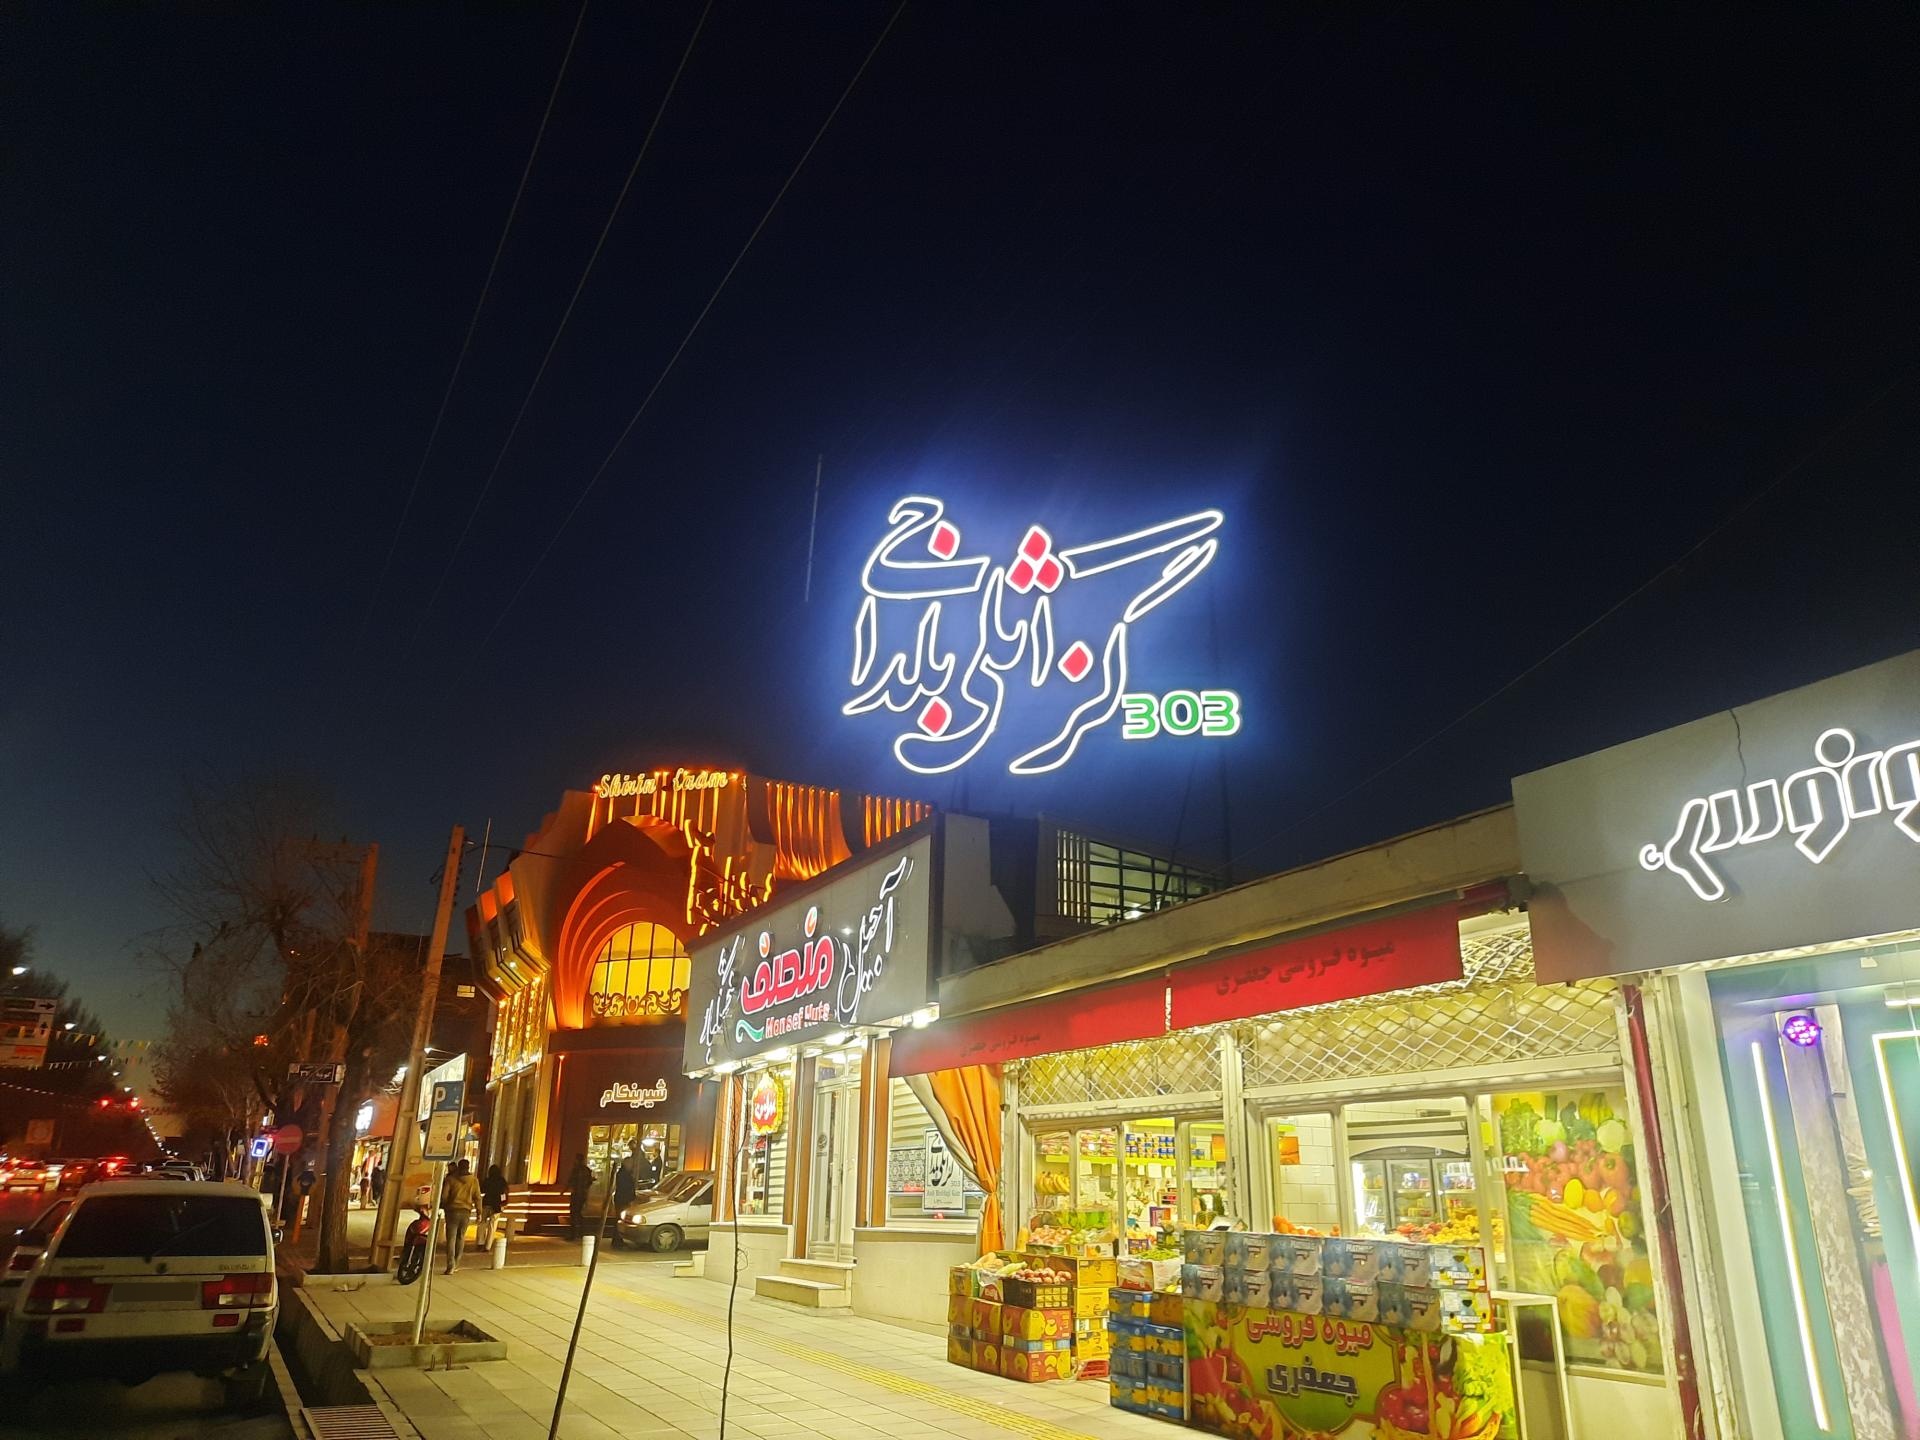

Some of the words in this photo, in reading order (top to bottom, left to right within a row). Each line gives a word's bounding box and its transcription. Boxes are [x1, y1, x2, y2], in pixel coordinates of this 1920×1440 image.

[1121, 690, 1241, 739] 303
[600, 773, 656, 799] Shirin
[741, 906, 834, 1015] منصف
[837, 856, 908, 1027] آجیل
[1346, 940, 1395, 968] میوه
[1216, 964, 1273, 996] جعفری
[1278, 945, 1342, 984] فروشی
[765, 1006, 804, 1039] Monsef
[804, 1001, 830, 1028] Nuts
[433, 1086, 446, 1110] P
[1246, 1309, 1318, 1347] فروشی
[1321, 1317, 1374, 1355] میوه
[1265, 1354, 1360, 1407] جعفری
